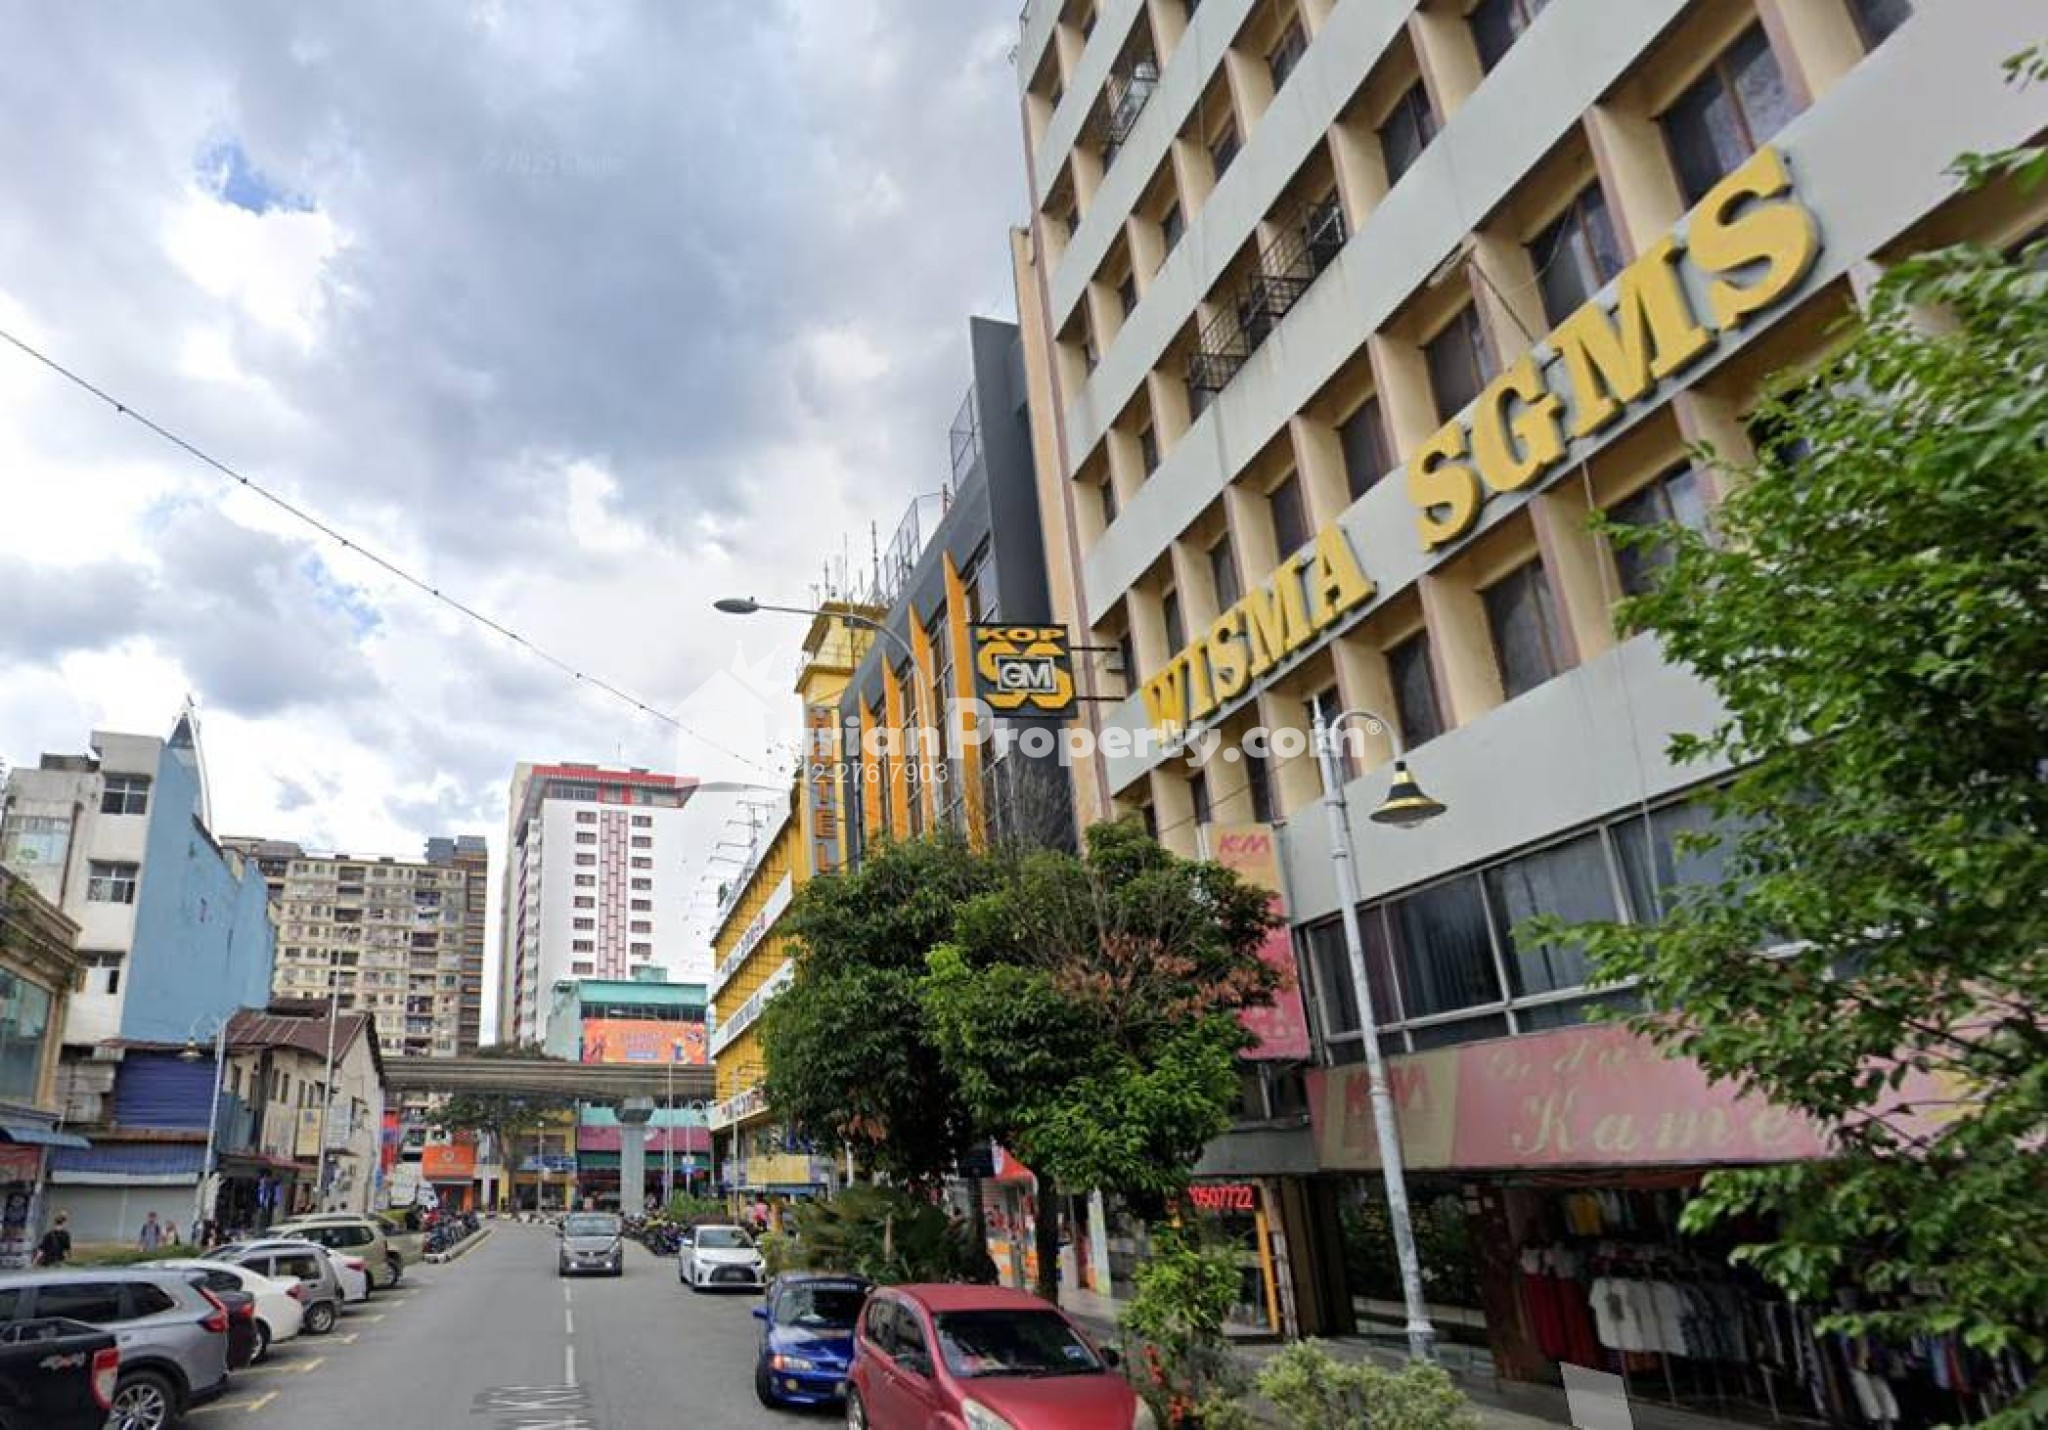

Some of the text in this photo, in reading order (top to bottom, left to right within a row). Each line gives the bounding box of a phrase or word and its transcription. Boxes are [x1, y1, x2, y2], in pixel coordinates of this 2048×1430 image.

[1141, 144, 1820, 748] WISMA SGMS
[976, 627, 1064, 641] KOP
